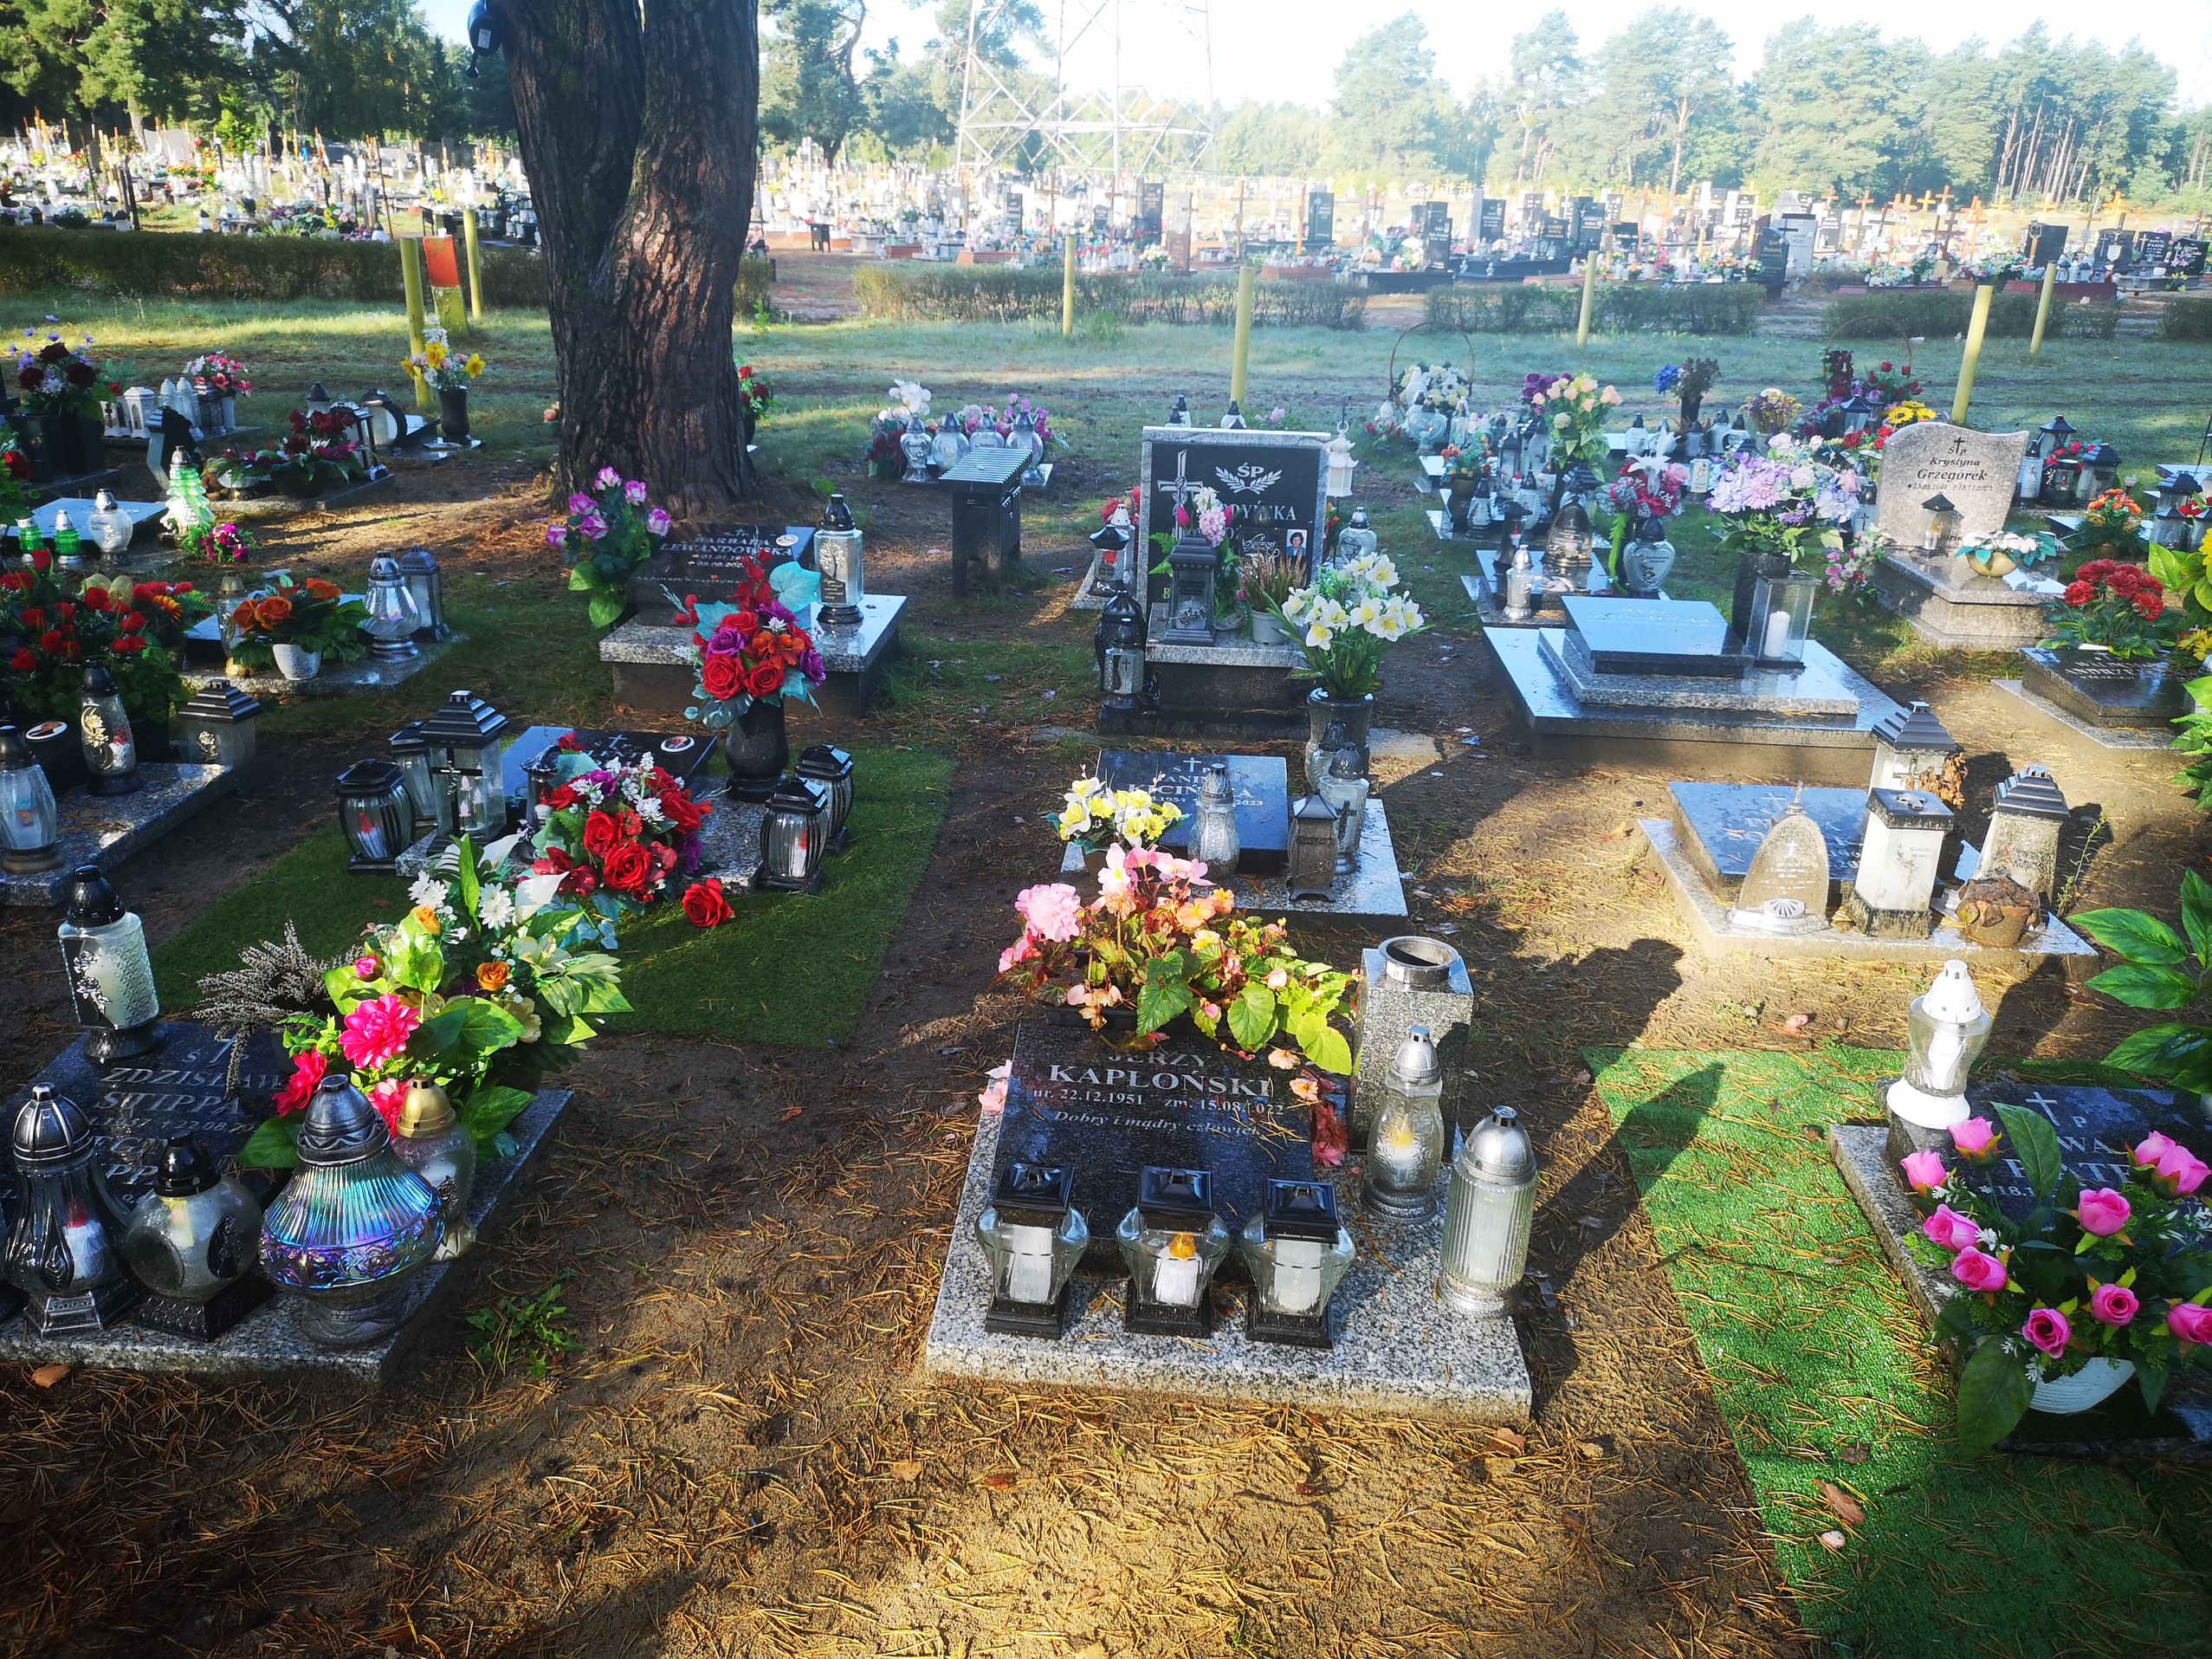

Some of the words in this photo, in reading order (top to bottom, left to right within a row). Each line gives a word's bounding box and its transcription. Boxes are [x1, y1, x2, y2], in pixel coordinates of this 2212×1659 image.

[1929, 457, 1981, 467] Krystyna
[1917, 469, 1988, 483] Grzegorek
[660, 543, 793, 556] LEWANDOWSKA
[1048, 1064, 1271, 1098] KAPŁOŃSKI
[94, 1091, 242, 1116] STIPPA
[1033, 1088, 1054, 1098] ur.
[1060, 1088, 1143, 1105] 22.12.1951
[1164, 1098, 1193, 1109] zm.
[1054, 1111, 1109, 1126] Dobry
[1125, 1116, 1181, 1131] mądry
